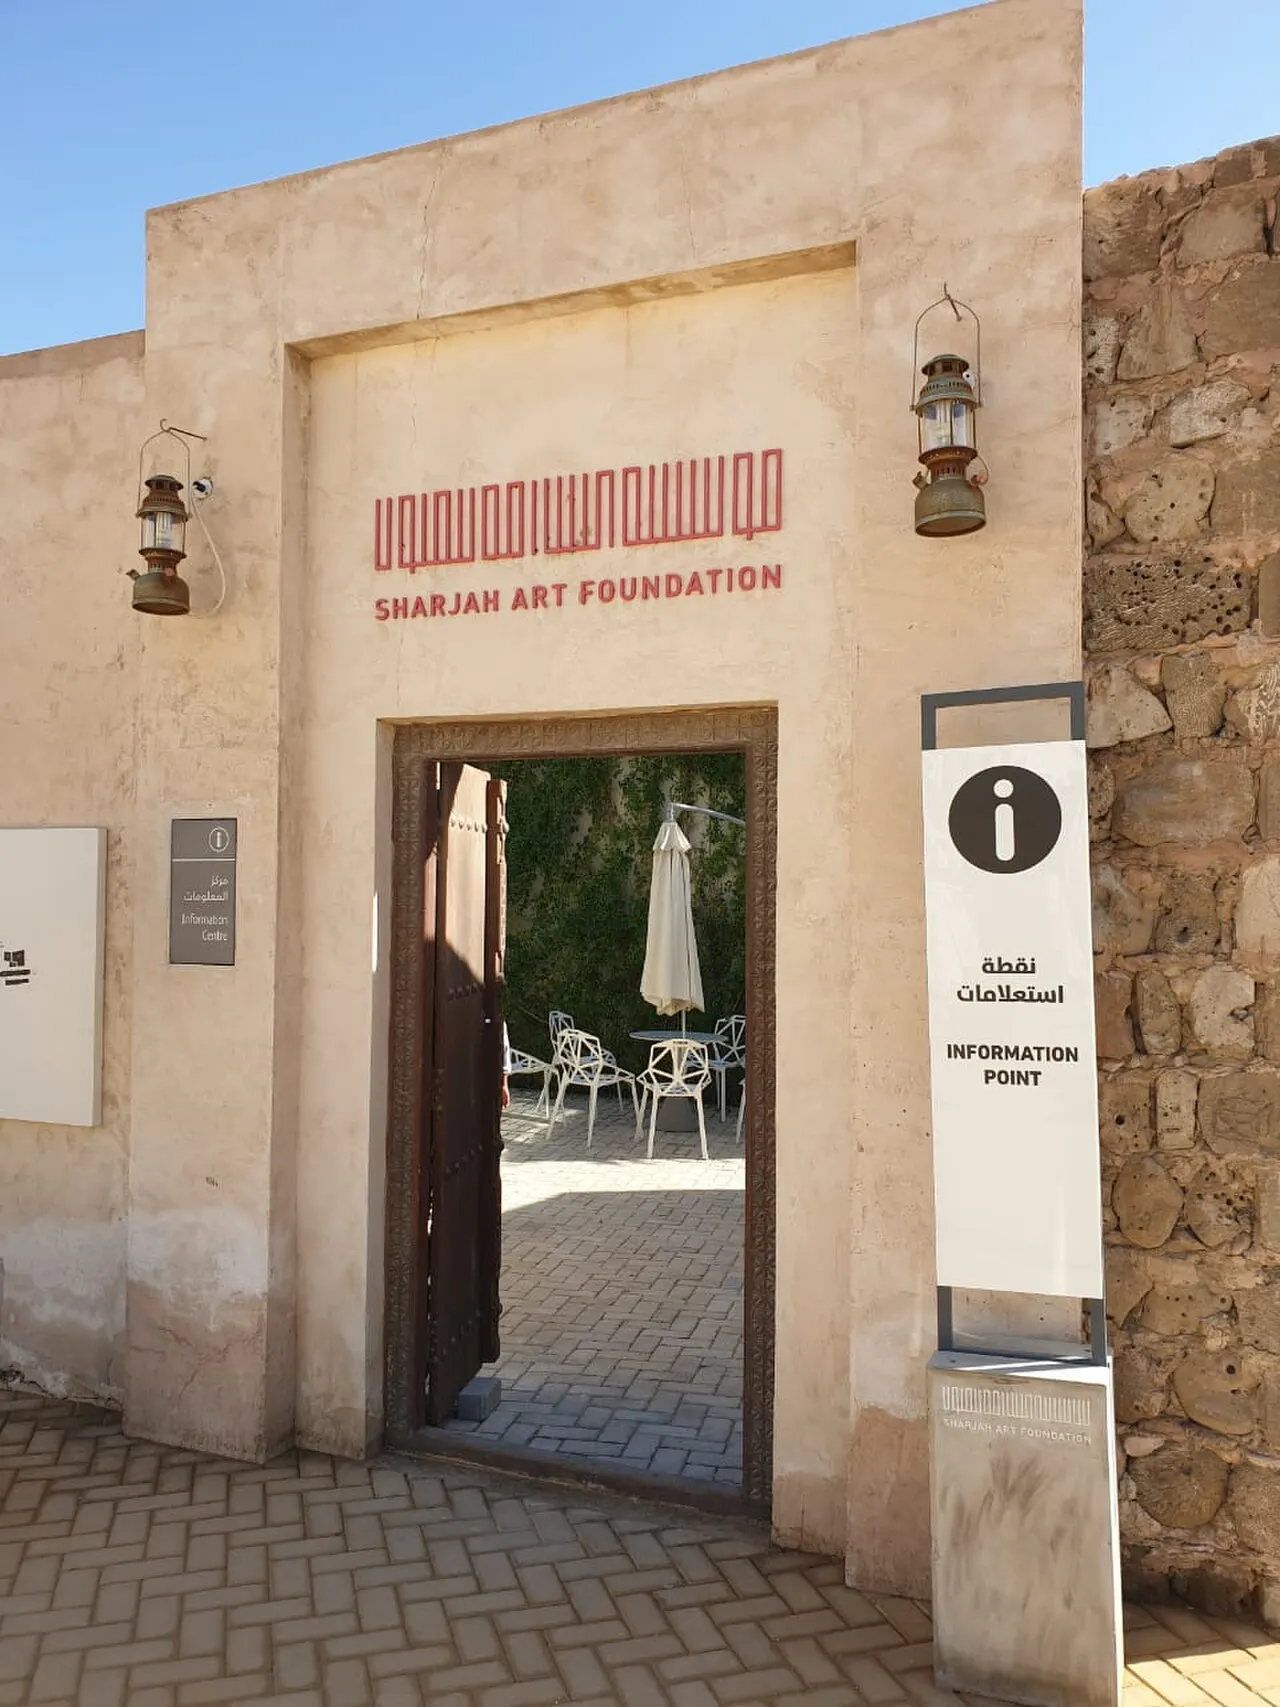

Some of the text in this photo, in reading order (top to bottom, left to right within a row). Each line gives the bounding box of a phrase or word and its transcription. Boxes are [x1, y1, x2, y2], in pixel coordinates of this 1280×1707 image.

[375, 564, 782, 621] SHARJAH ART FOUNDATION
[211, 875, 229, 887] مركز
[183, 891, 228, 903] المعلومات
[181, 913, 229, 925] Information
[201, 930, 228, 941] Centre
[981, 957, 1036, 974] نقطة
[956, 985, 1064, 1004] استعلامات
[947, 1044, 1078, 1062] INFORMATION
[984, 1069, 1042, 1086] POINT
[995, 1425, 1018, 1435] ART
[1020, 1427, 1092, 1443] FOUNDATION
